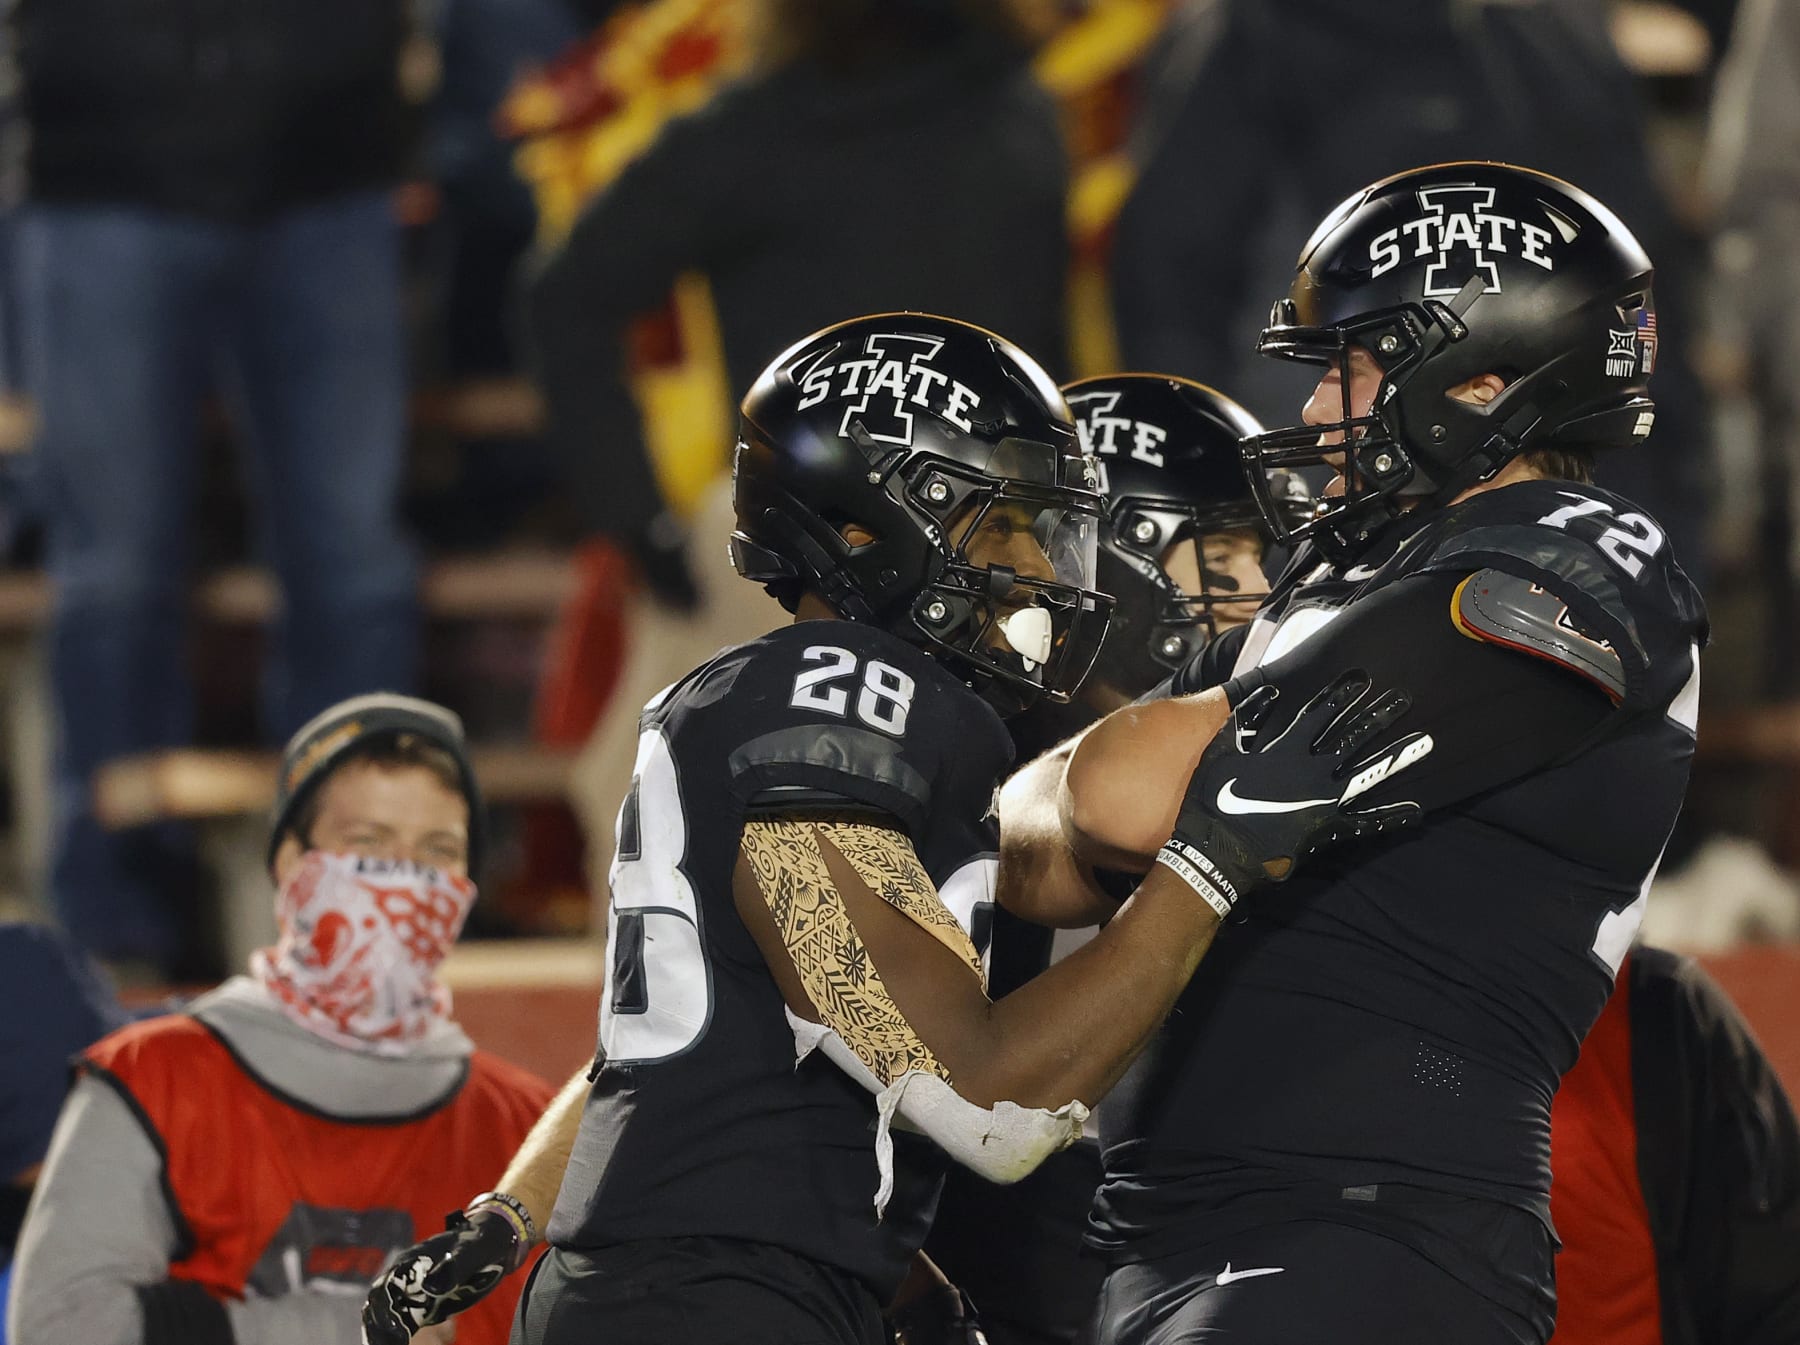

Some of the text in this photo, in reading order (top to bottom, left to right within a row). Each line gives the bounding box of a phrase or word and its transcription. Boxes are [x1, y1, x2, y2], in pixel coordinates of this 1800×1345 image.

[1368, 212, 1554, 280] STATE
[797, 359, 981, 435] STATE
[1605, 358, 1635, 378] UNITY
[1076, 416, 1168, 468] ATE
[1536, 490, 1665, 579] 72
[790, 645, 916, 736] 28
[598, 692, 709, 1065] 8
[1158, 850, 1192, 876] UMBLE
[1190, 874, 1216, 901] OVER
[1183, 846, 1214, 873] LIVES
[1210, 870, 1239, 905] MATTE
